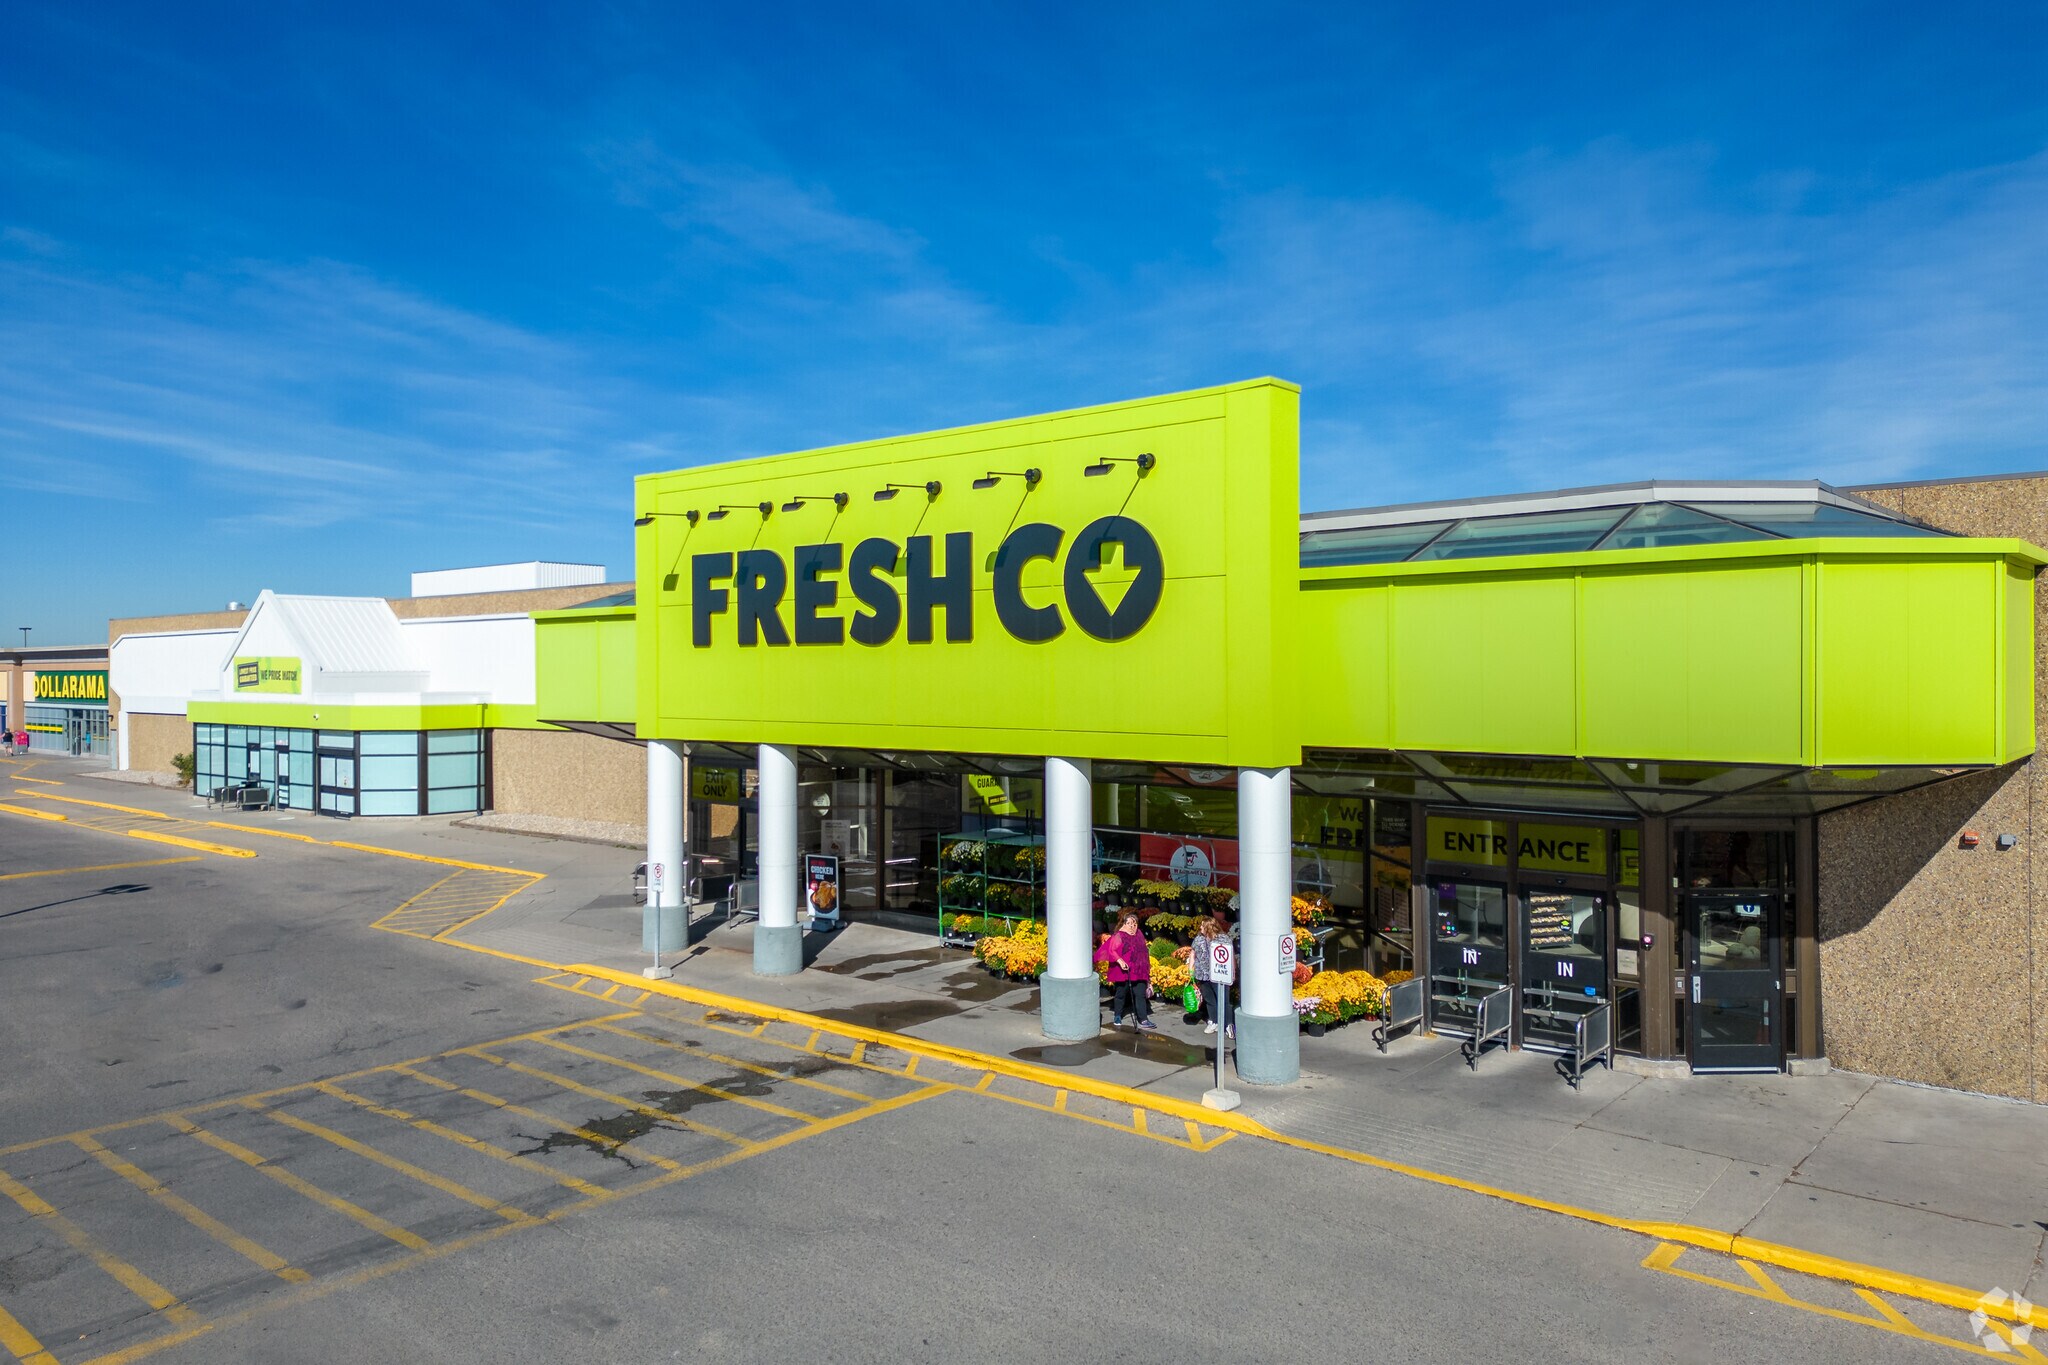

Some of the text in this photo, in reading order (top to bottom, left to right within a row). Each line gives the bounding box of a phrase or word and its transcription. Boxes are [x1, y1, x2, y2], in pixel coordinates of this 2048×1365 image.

[33, 675, 106, 698] DOLLARAMA
[706, 771, 725, 783] EXIT
[703, 784, 727, 797] ONLY
[1463, 950, 1477, 964] IN
[1557, 961, 1573, 977] IN
